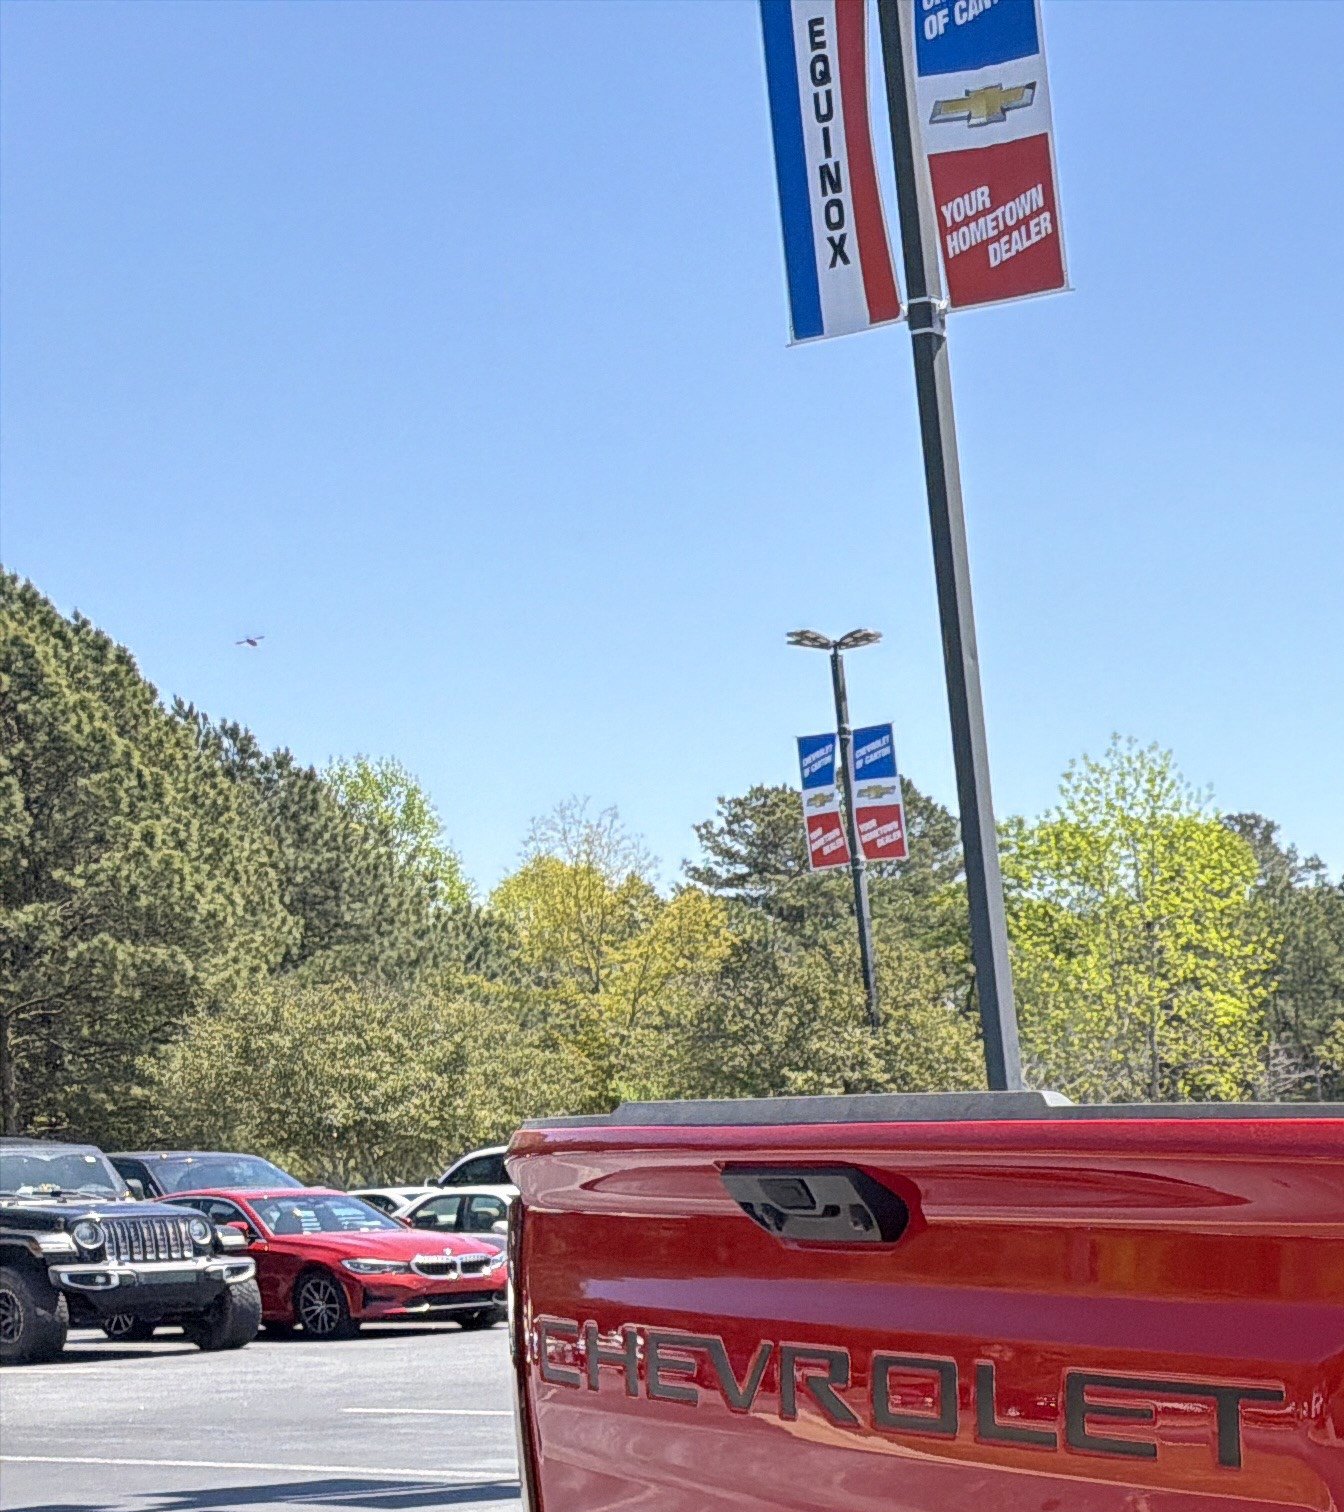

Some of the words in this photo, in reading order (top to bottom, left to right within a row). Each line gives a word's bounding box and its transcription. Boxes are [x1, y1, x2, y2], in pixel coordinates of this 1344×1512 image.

[924, 8, 949, 40] OF
[808, 17, 850, 269] EQUINOX
[940, 185, 991, 227] YOUR
[946, 183, 1044, 259] HOMETOWN
[987, 211, 1053, 268] DEALER
[533, 1315, 1285, 1470] CHEVROLET
